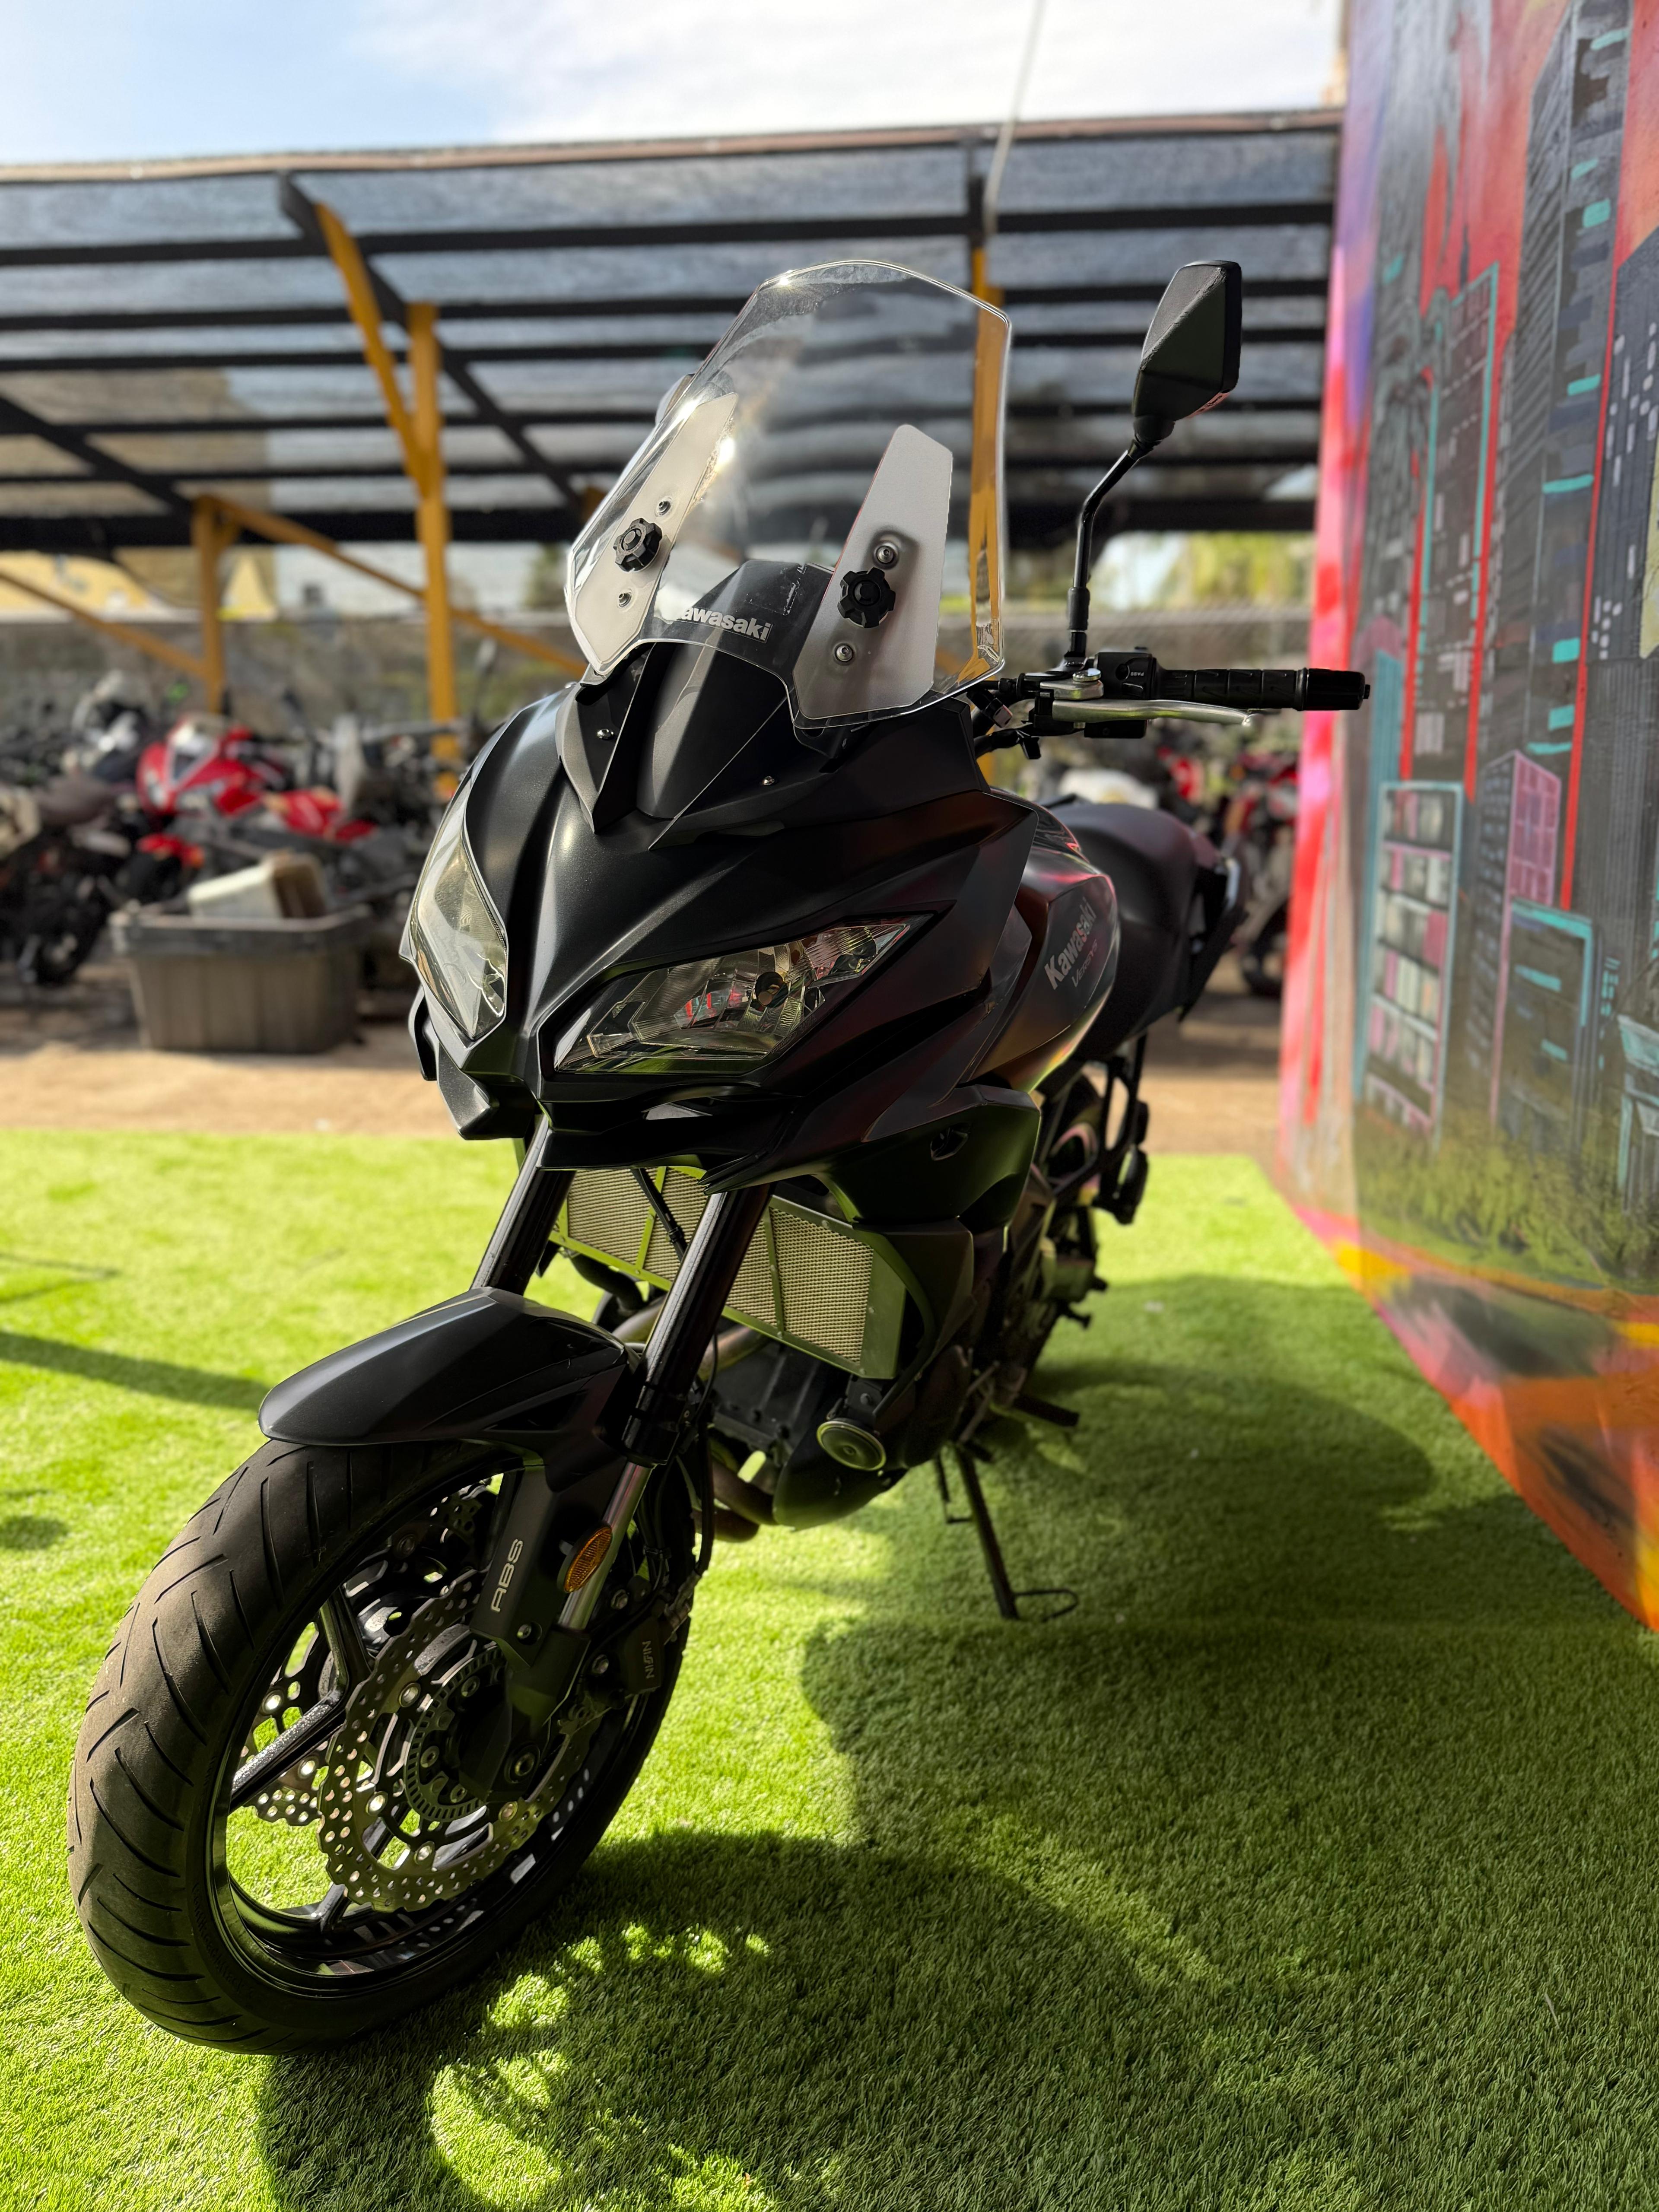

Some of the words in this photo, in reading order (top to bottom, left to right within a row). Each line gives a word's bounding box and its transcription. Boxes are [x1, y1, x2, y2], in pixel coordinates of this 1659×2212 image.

[681, 607, 772, 641] awasaki
[1044, 896, 1097, 990] Kawasaki
[491, 1538, 523, 1612] ABS
